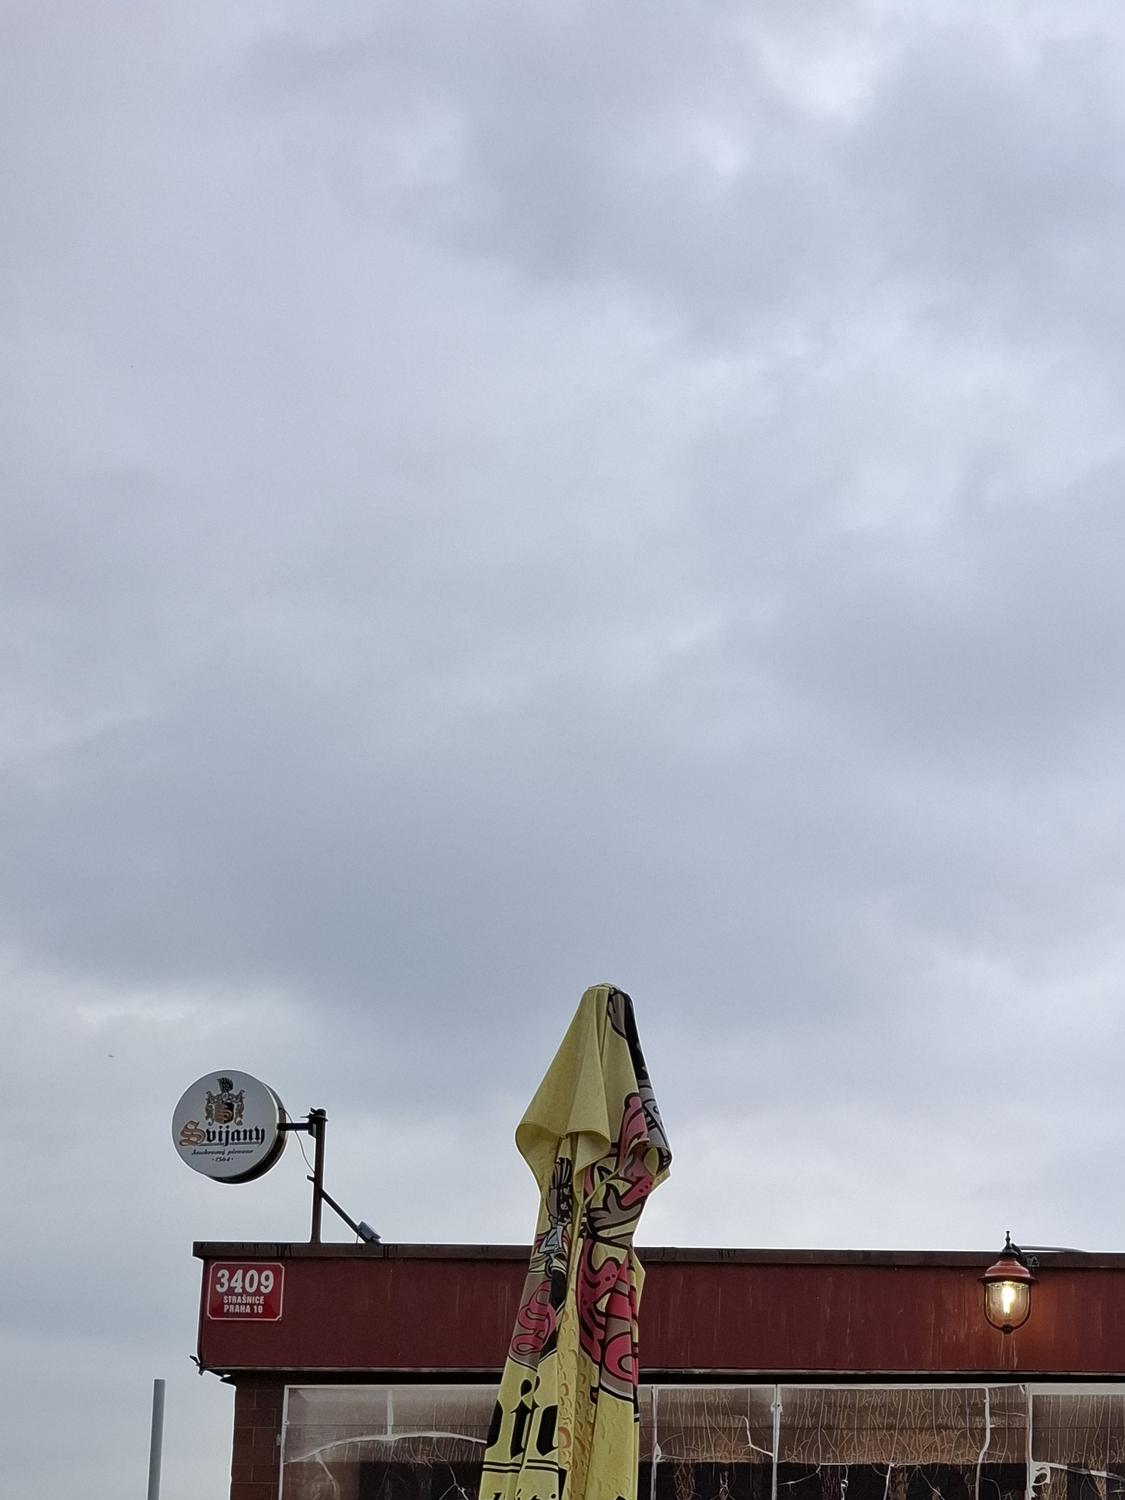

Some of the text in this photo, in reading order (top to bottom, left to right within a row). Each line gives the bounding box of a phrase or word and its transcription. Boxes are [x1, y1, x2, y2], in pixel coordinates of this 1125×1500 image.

[179, 1120, 265, 1147] Svijany
[216, 1269, 274, 1294] 3409
[223, 1294, 264, 1305] STRAŠNICE
[224, 1304, 263, 1314] PRAHA 10
